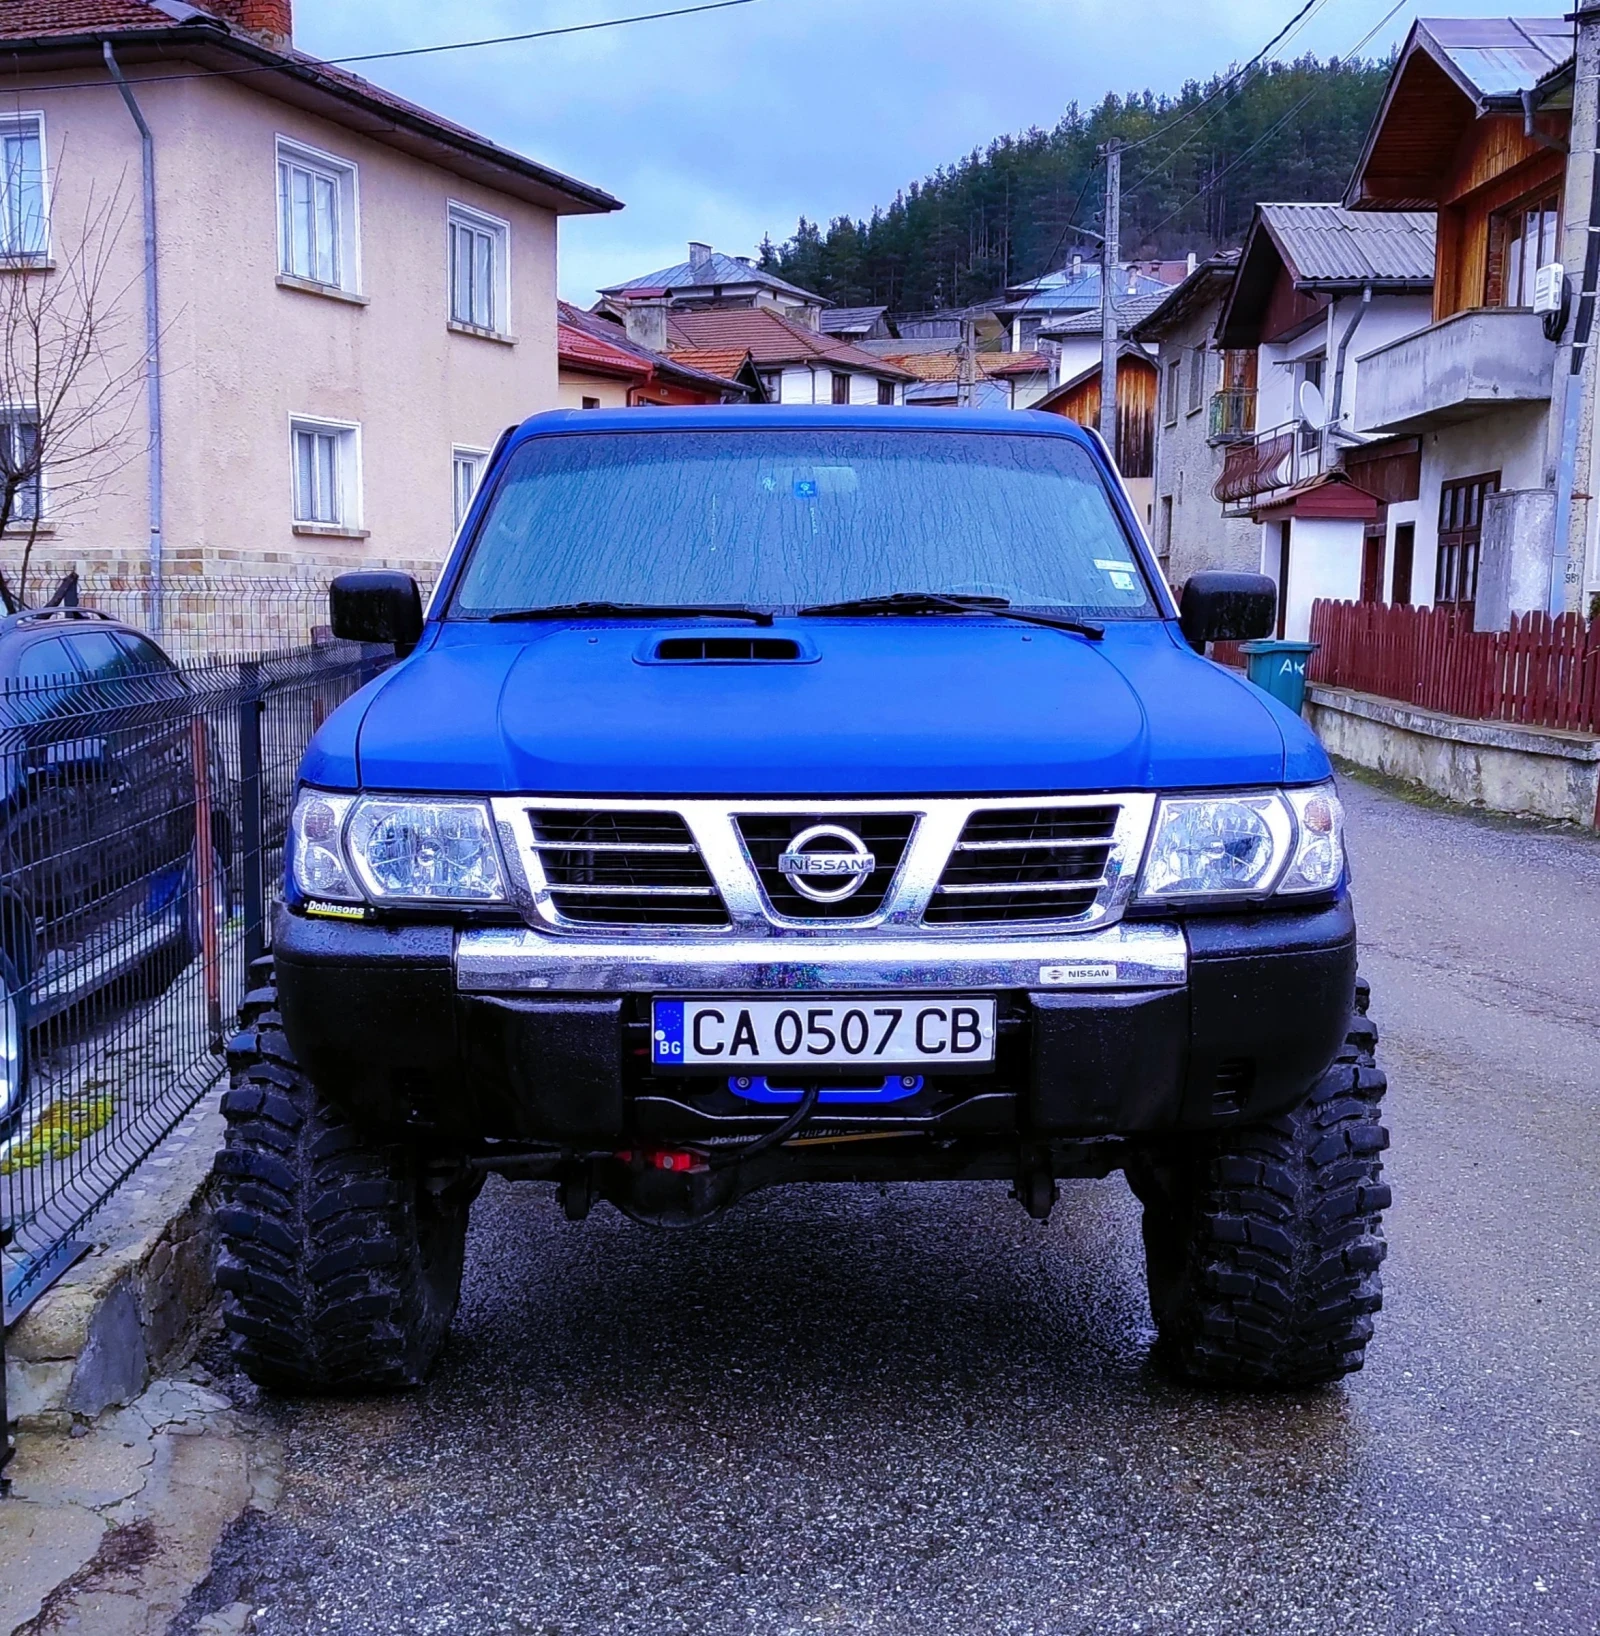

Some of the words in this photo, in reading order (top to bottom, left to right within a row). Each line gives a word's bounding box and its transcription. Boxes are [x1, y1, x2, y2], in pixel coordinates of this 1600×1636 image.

[789, 859, 864, 870] NISSAN
[308, 900, 365, 915] Dobinsons
[1068, 970, 1109, 978] NISSAN
[693, 1008, 759, 1056] CA
[774, 1008, 902, 1056] 0507
[915, 1007, 982, 1054] CB
[659, 1041, 681, 1055] BG
